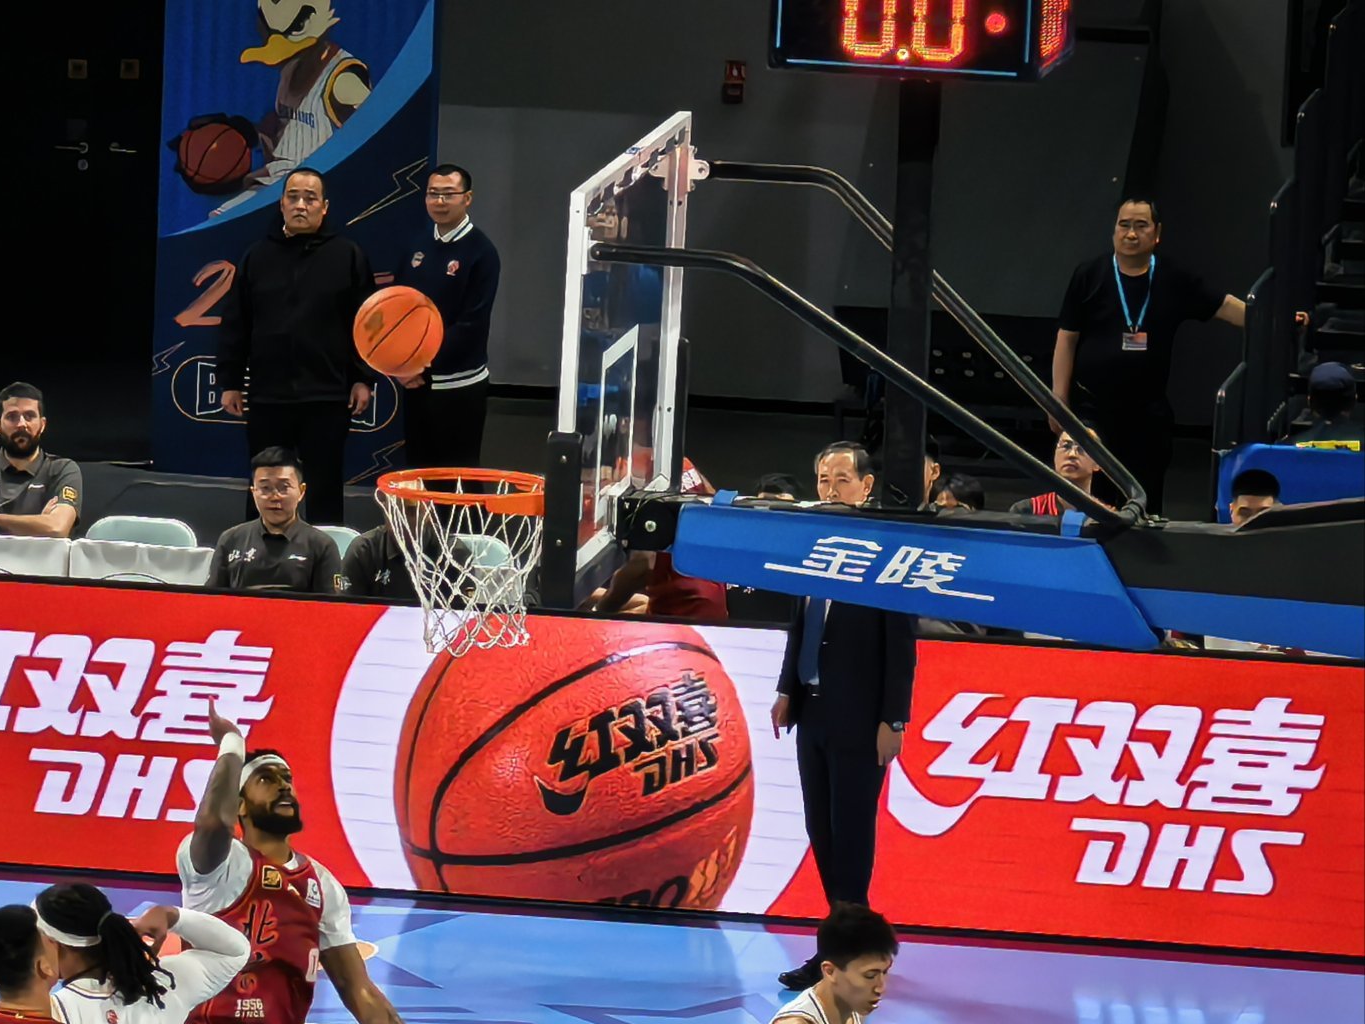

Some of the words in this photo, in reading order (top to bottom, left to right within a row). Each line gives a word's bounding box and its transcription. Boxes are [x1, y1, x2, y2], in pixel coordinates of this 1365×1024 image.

[764, 536, 994, 601] 金陵
[534, 669, 717, 815] 红双喜
[632, 735, 719, 797] DHS
[888, 692, 1326, 836] 红双喜
[1069, 818, 1305, 896] DHS
